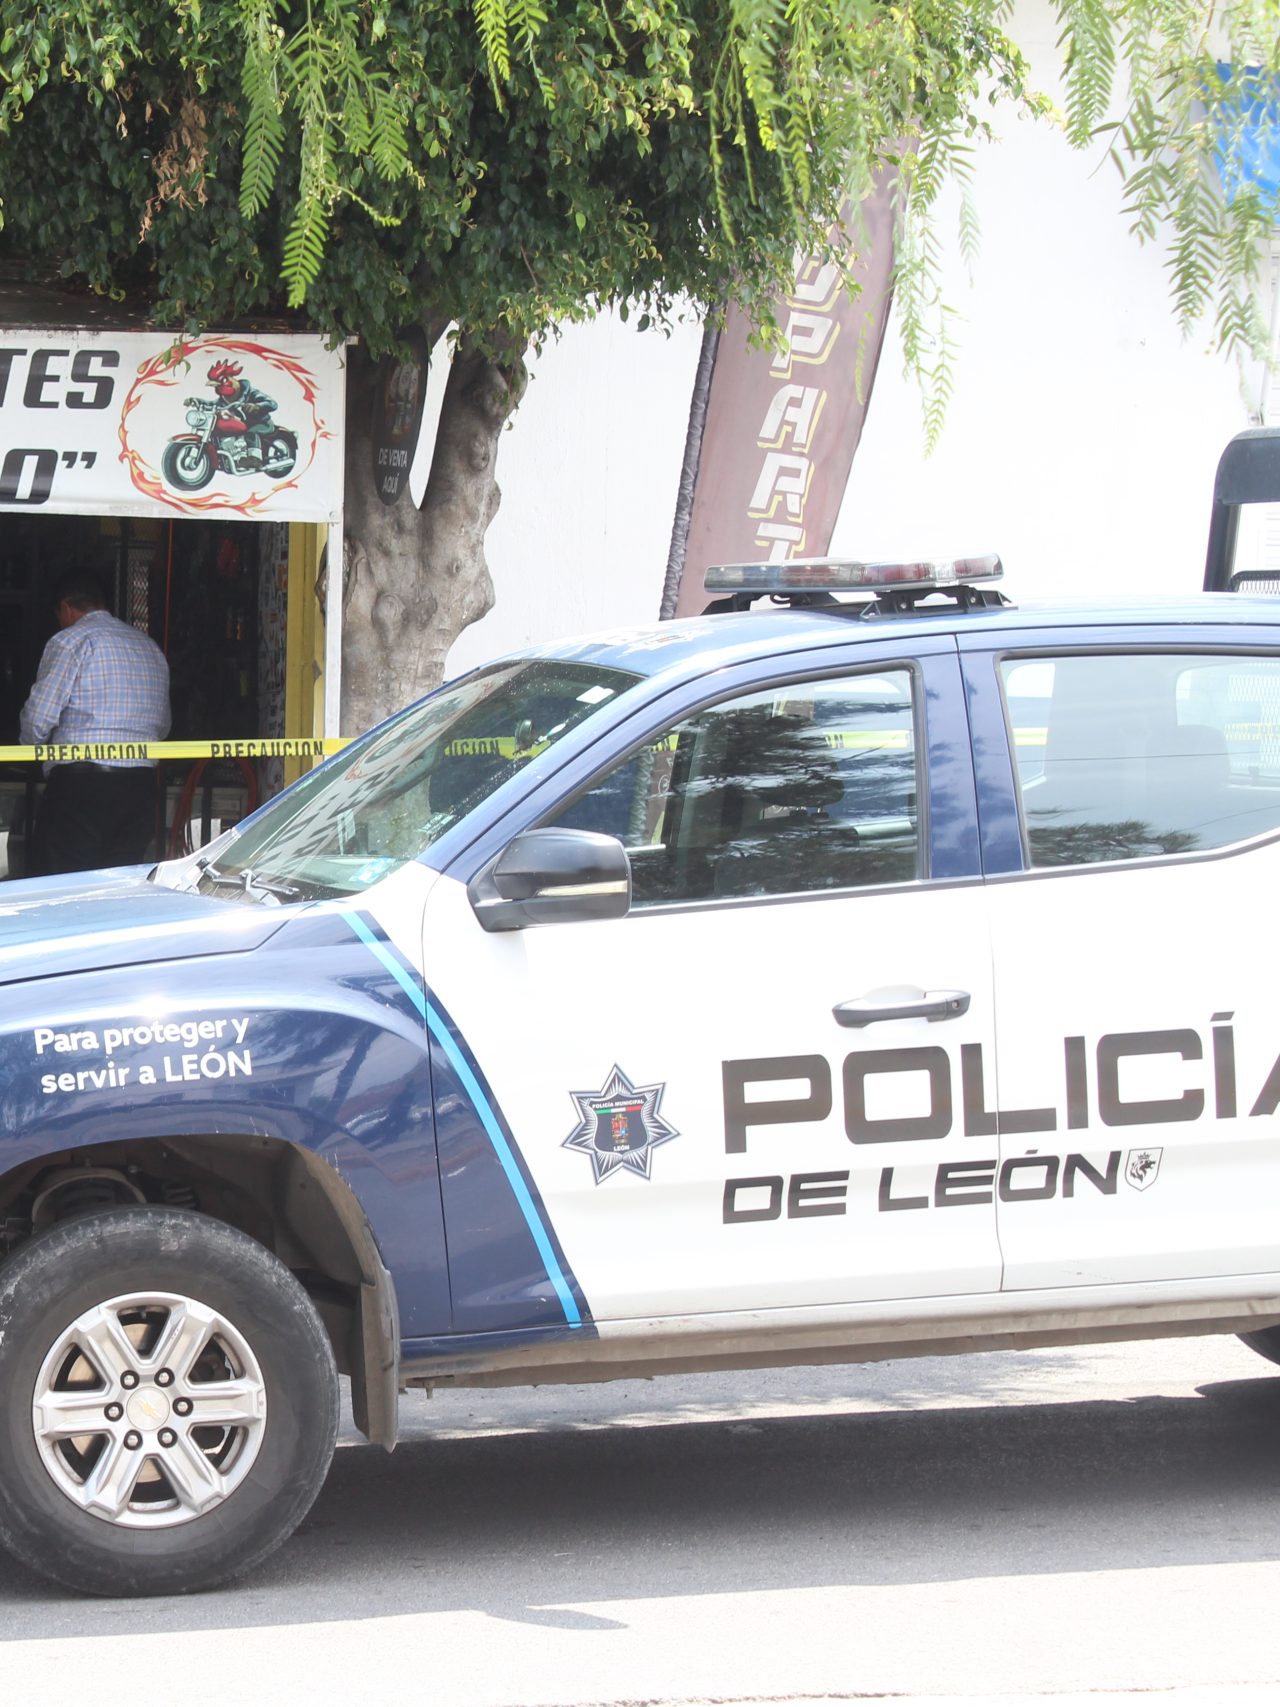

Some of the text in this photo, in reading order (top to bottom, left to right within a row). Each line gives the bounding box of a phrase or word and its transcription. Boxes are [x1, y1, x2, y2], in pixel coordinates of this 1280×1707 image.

[34, 743, 148, 761] PRECAUCION
[211, 740, 323, 758] PRECAUCION
[33, 1017, 249, 1055] Para proteger y
[40, 1045, 252, 1094] servir a LEÓN
[722, 1149, 1122, 1225] DE LEÓN
